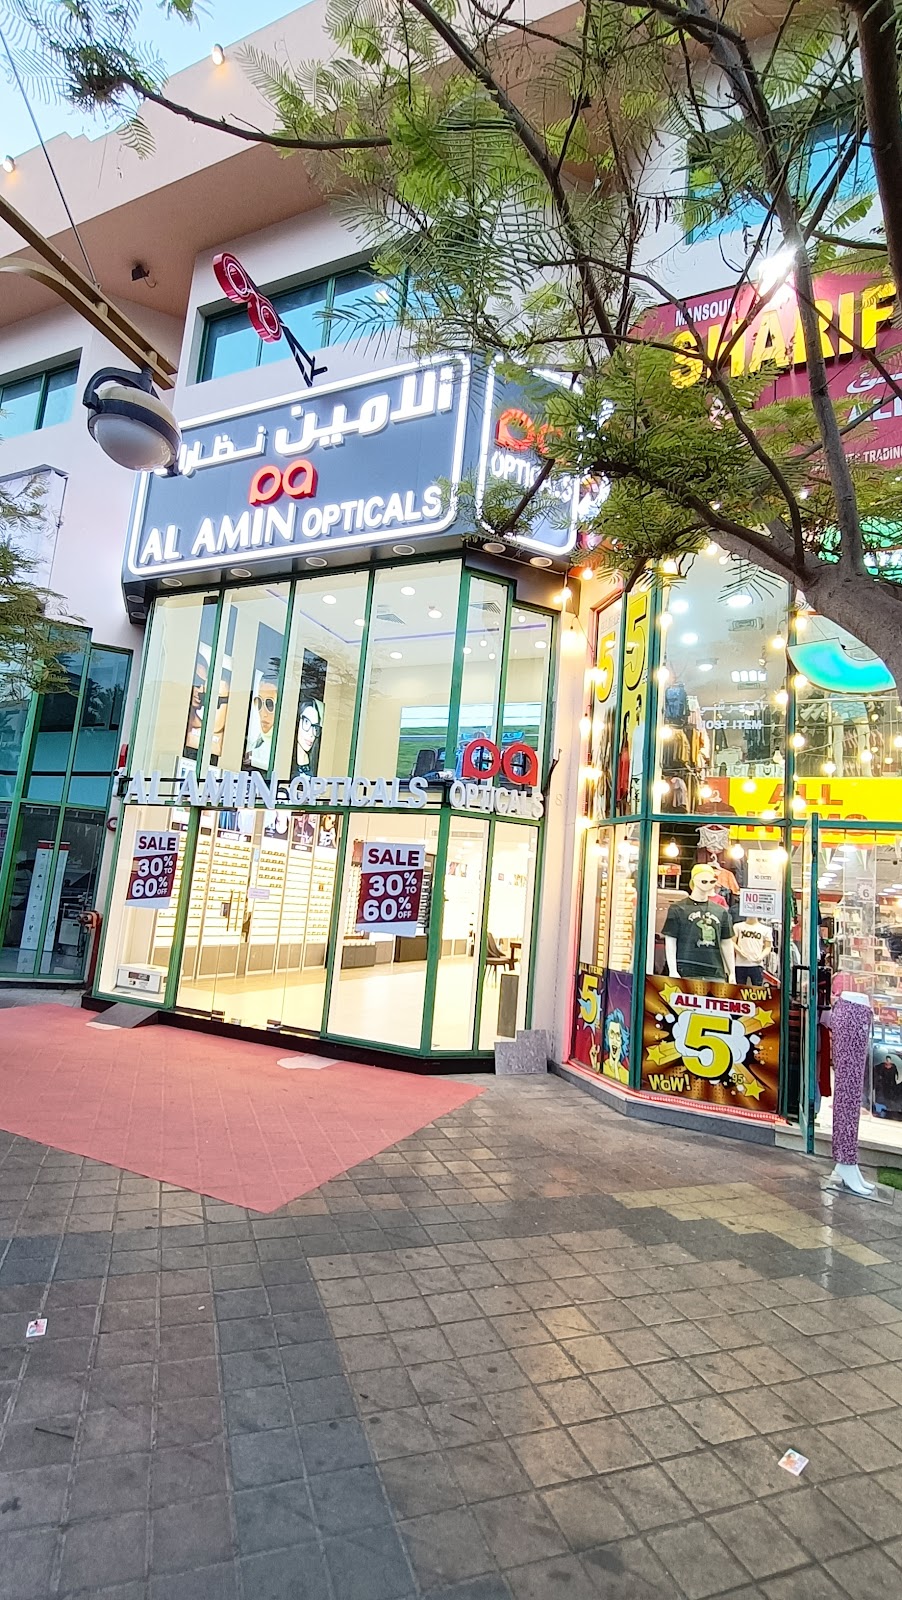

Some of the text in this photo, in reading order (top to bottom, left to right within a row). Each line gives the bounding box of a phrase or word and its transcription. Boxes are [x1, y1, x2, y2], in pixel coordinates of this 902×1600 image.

[670, 282, 897, 389] SHARIF
[863, 445, 902, 463] TRADIN
[139, 485, 442, 565] AL AMIN OPTICALS
[123, 770, 429, 809] AL AMIN OPTICALS
[450, 780, 544, 818] OPTICALS
[138, 835, 177, 851] SALE
[367, 848, 420, 867] SALE
[157, 887, 168, 895] OFF
[405, 886, 417, 894] TO
[745, 893, 759, 903] NO
[397, 911, 412, 919] OFF
[580, 974, 598, 1024] 5
[674, 995, 751, 1014] ALL ITEMS
[682, 1013, 732, 1079] 5
